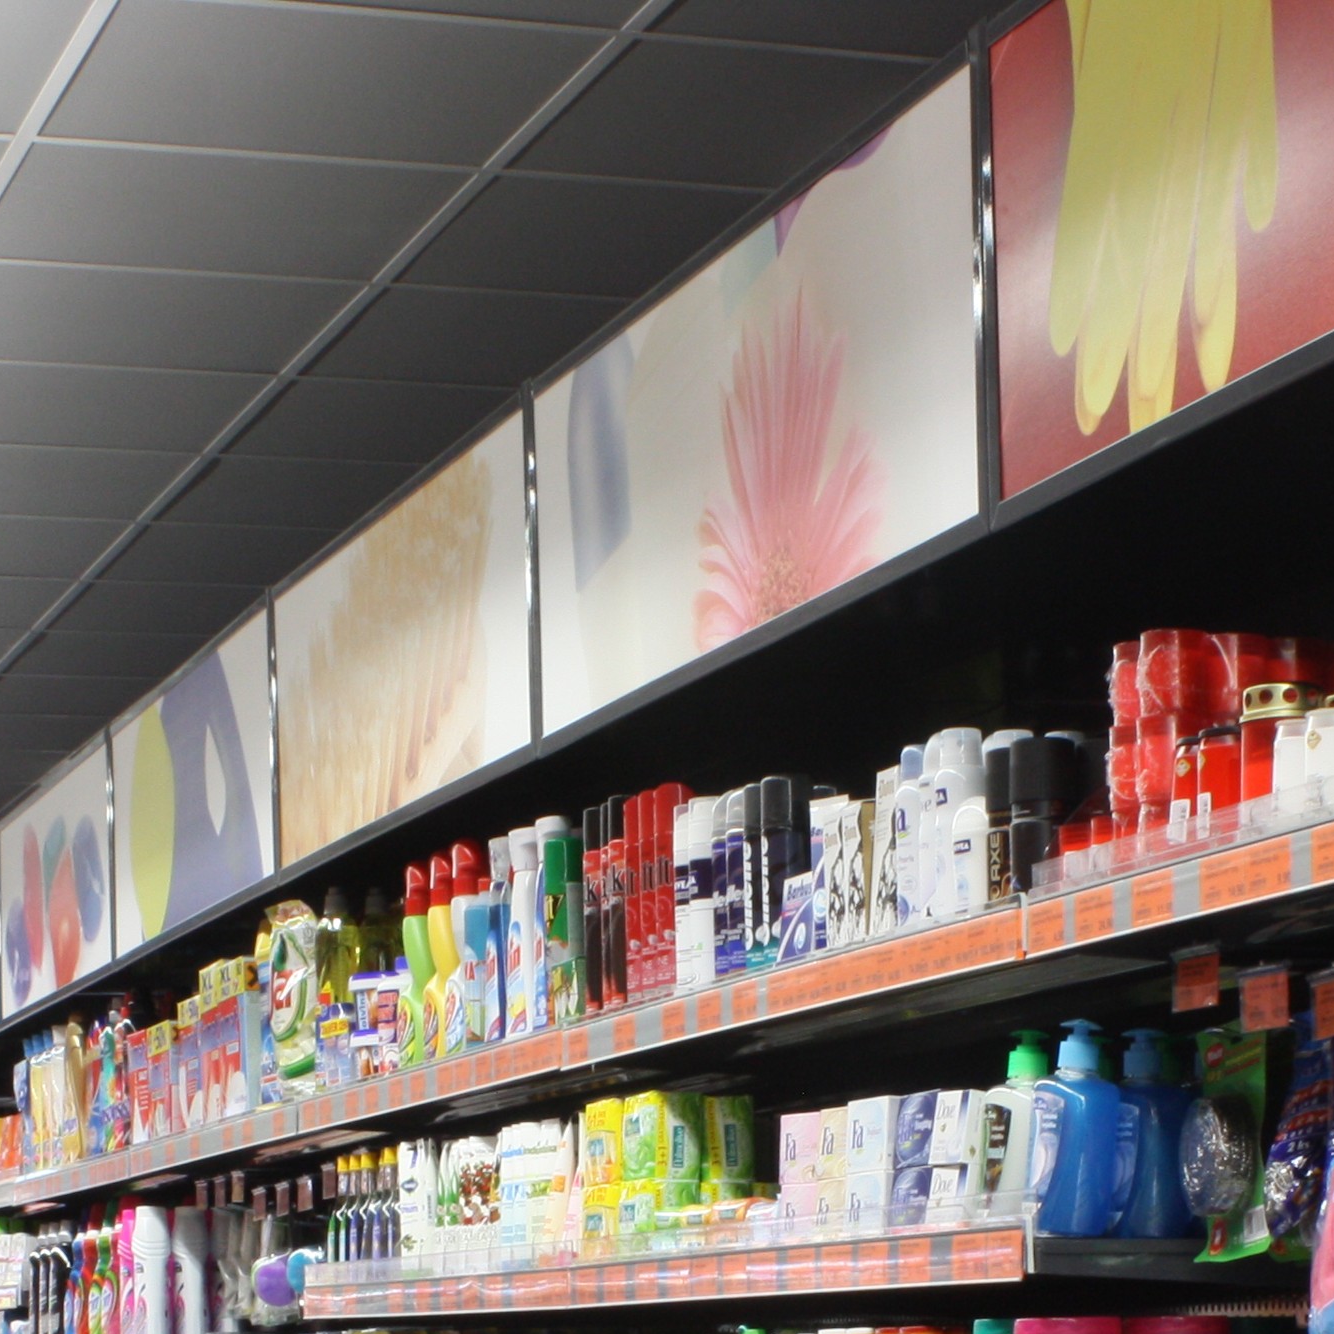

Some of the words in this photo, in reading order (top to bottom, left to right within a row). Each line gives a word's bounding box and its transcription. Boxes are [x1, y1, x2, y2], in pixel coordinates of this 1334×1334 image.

[989, 832, 1002, 881] AXE
[937, 1102, 957, 1119] Dove
[784, 1132, 797, 1162] Fa
[821, 1126, 835, 1156] Fa
[851, 1118, 865, 1149] Fa
